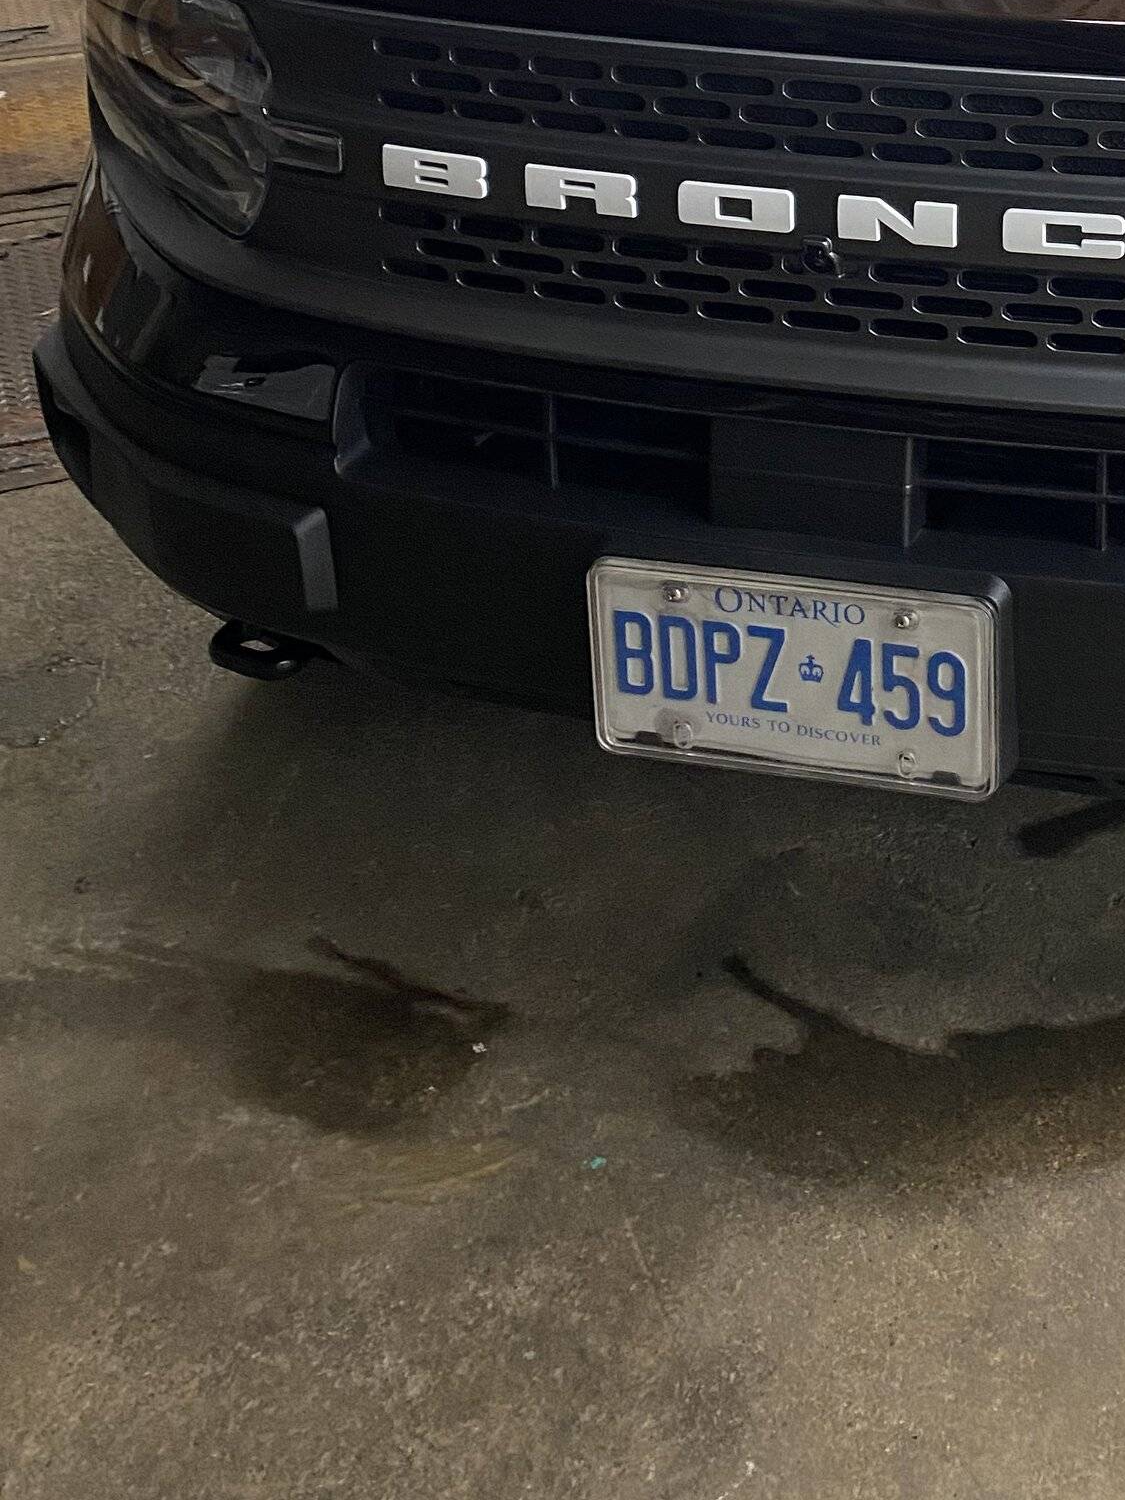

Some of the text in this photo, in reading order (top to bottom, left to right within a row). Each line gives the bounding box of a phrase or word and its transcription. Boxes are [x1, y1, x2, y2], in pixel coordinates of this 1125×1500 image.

[612, 609, 966, 737] BDPZ 459
[705, 710, 881, 746] YOURS TO DISCOVER
